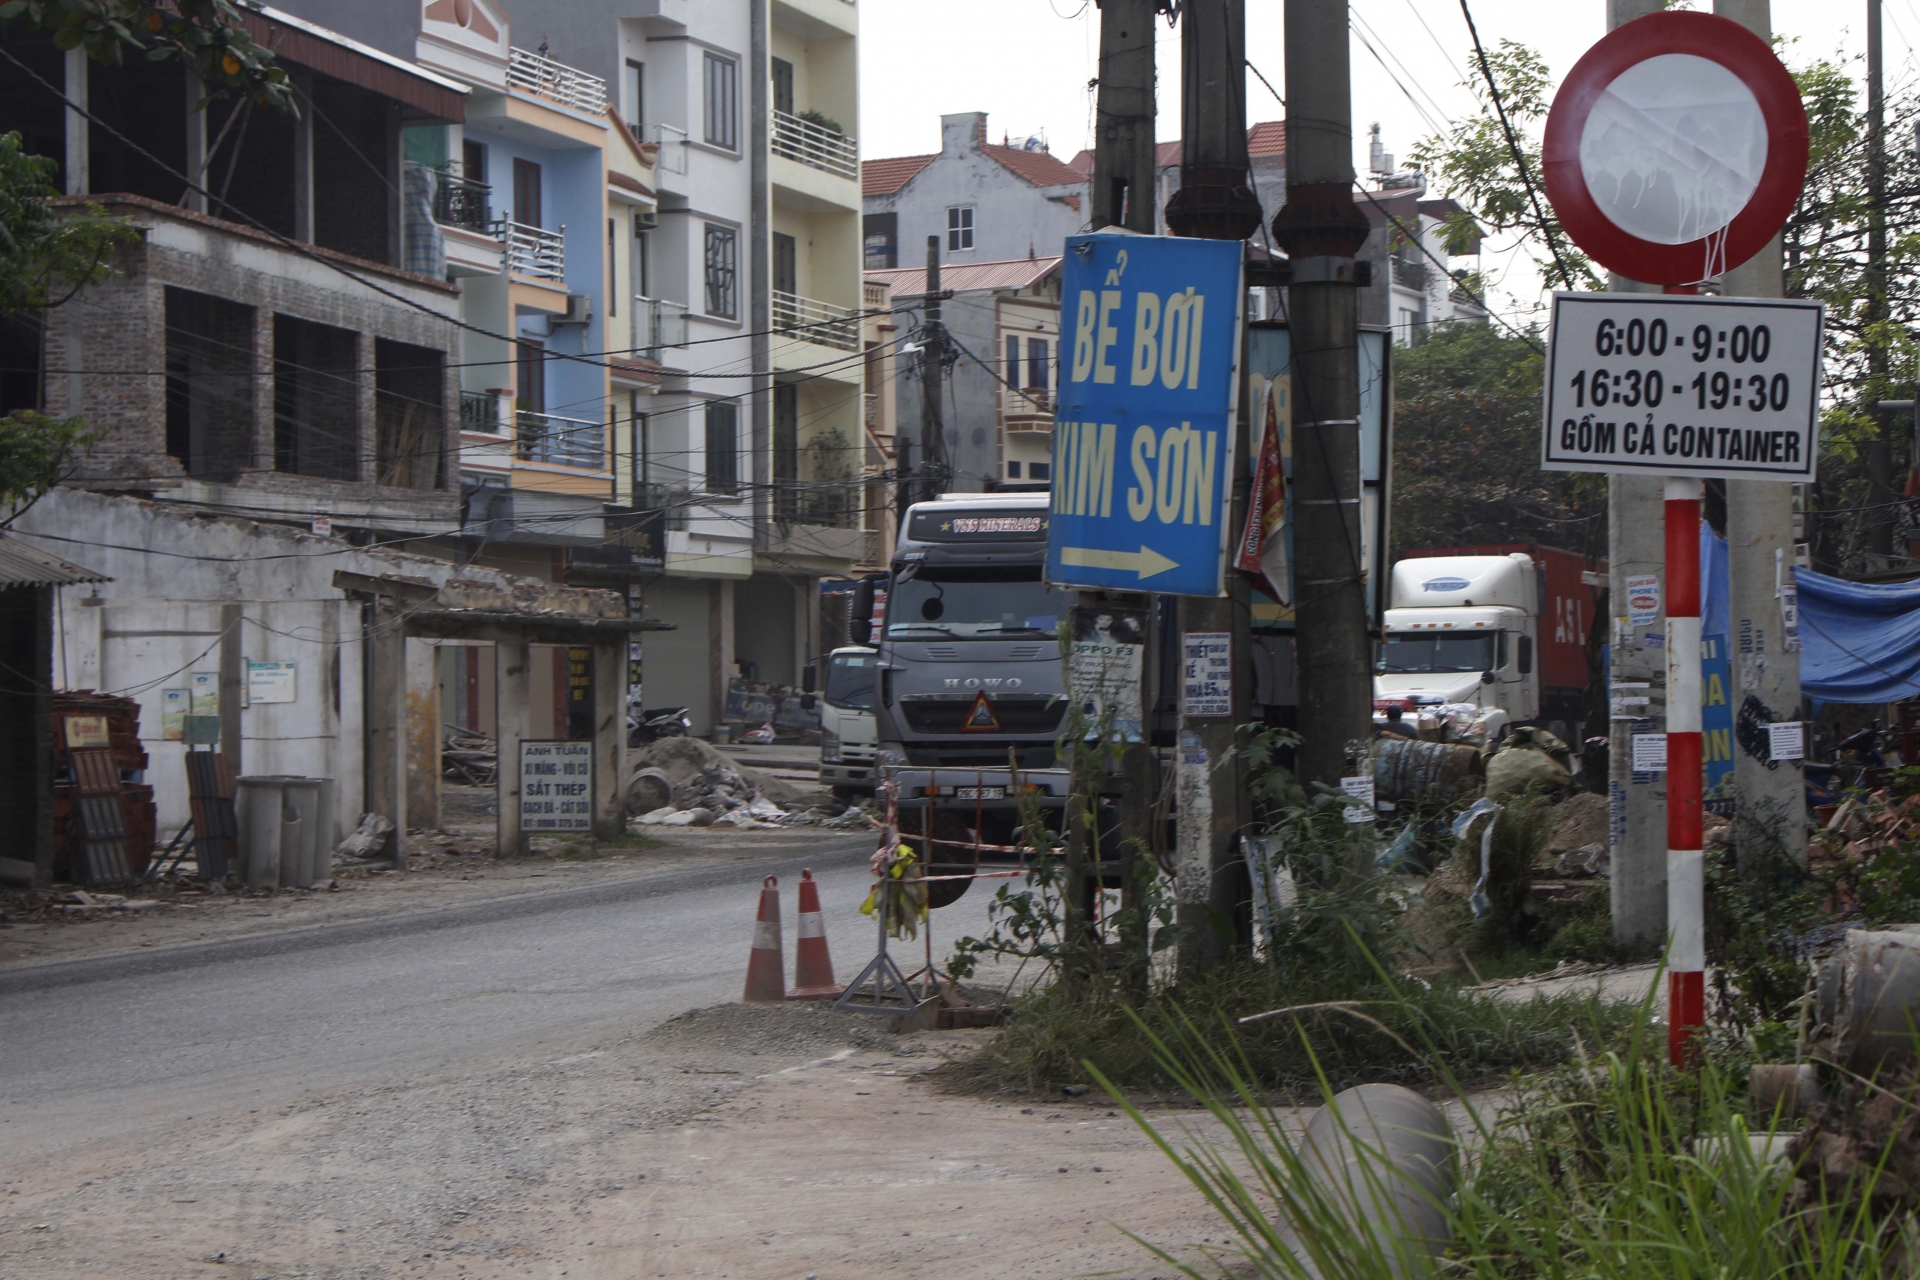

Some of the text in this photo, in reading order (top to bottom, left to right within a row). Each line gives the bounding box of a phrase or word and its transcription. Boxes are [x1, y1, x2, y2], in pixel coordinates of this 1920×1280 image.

[1071, 249, 1205, 390] BỂ BƠI
[1596, 318, 1668, 356] 6:00
[1692, 324, 1771, 363] 9:00
[1571, 369, 1663, 408] 16:30
[1691, 371, 1789, 412] 19:30
[1561, 413, 1800, 463] GỒM CẢ CONTAINER
[1054, 421, 1118, 518] KIM
[1127, 421, 1217, 526] SƠN
[978, 517, 1041, 533] MINERALS
[1555, 596, 1586, 646] ASL
[943, 678, 1022, 689] HOWO
[525, 747, 551, 756] ANH
[526, 779, 587, 796] SẮT THÉP
